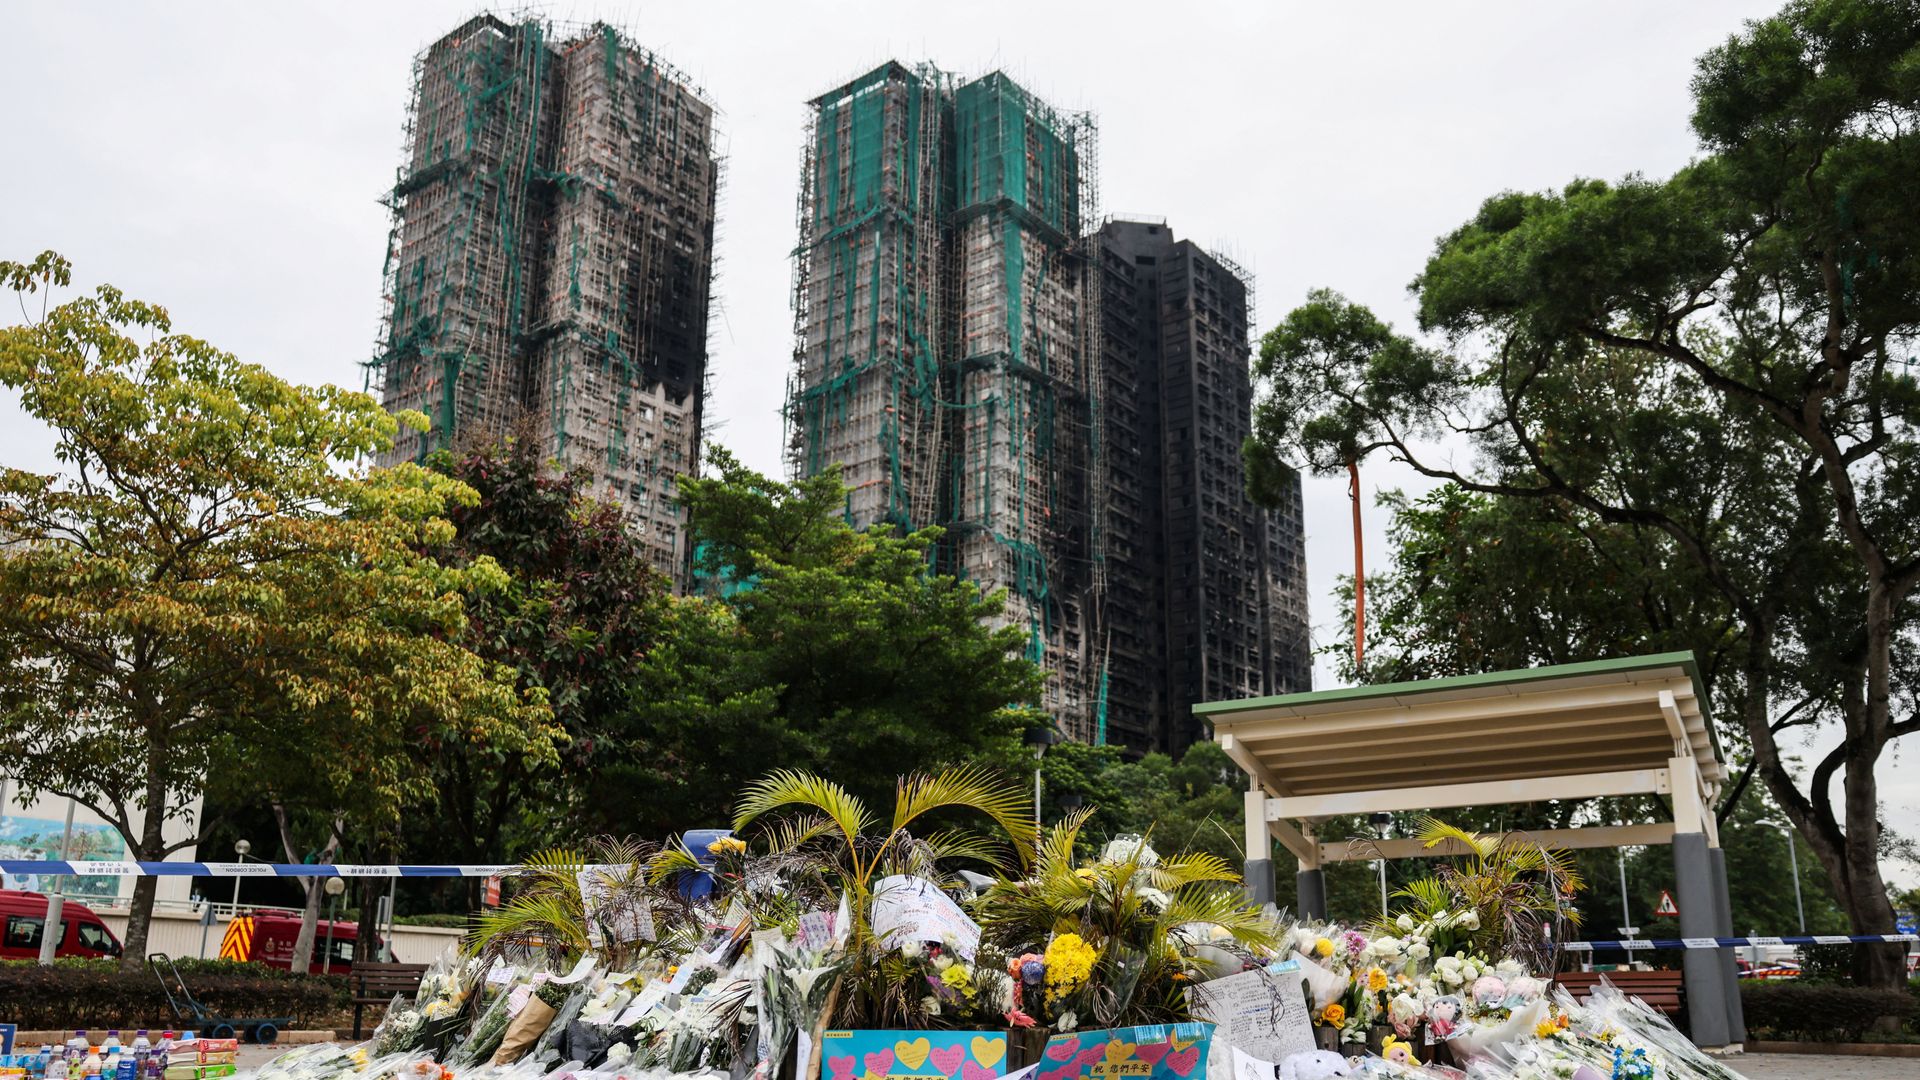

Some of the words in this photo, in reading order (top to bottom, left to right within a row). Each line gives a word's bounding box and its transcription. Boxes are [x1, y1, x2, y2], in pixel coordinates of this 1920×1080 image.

[1093, 1065, 1104, 1073] 祝
[1109, 1063, 1151, 1073] 您們平安
